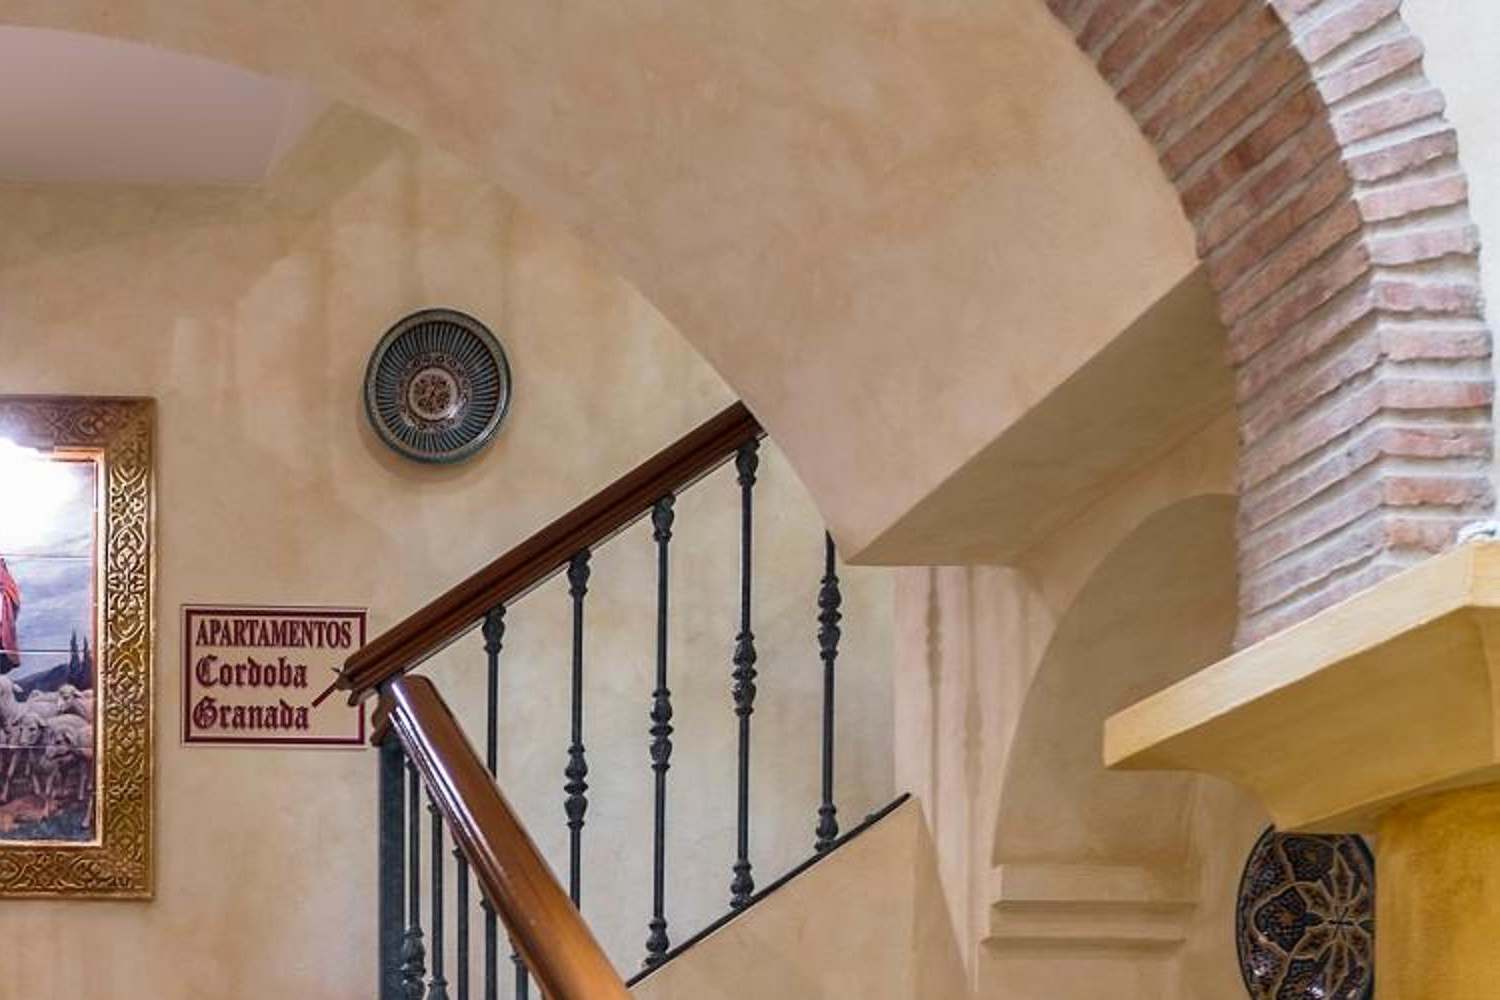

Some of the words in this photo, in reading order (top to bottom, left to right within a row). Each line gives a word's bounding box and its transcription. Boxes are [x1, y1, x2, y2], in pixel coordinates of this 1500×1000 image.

[195, 619, 352, 648] APARTAMENTOS
[195, 654, 308, 689] Cordoba
[193, 695, 309, 731] Granada
